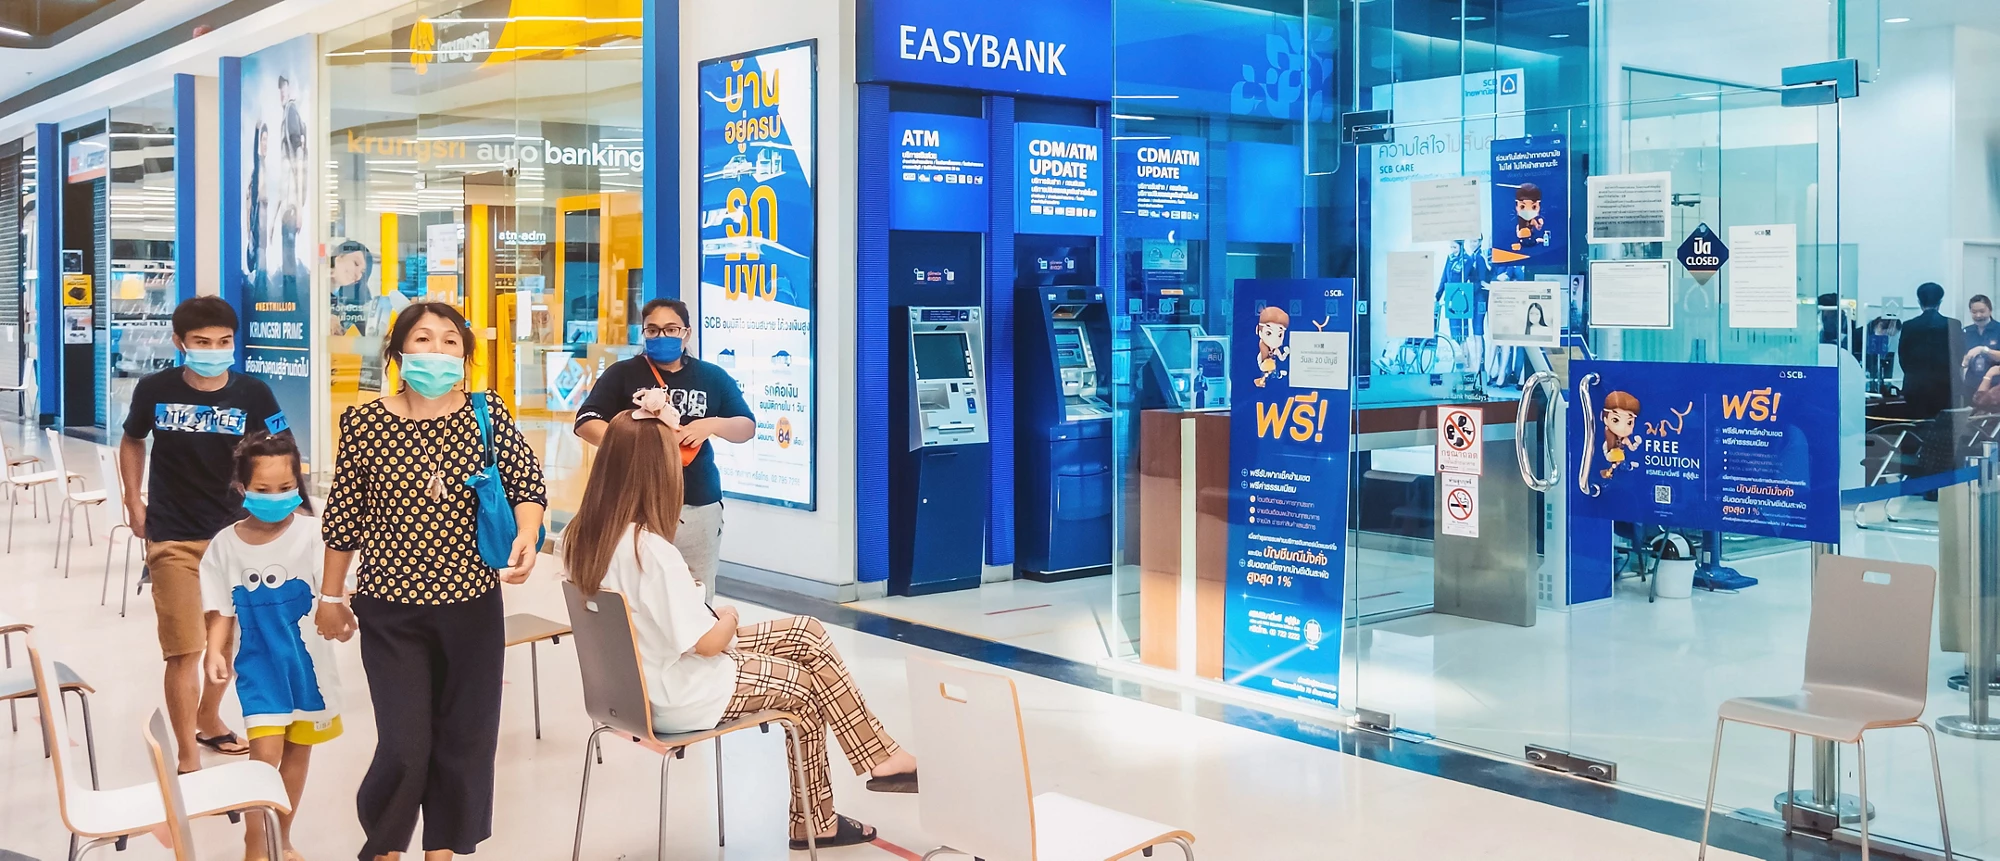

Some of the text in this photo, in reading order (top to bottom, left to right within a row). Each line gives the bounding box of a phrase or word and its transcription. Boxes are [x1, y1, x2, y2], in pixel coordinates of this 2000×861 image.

[900, 25, 1067, 76] EASYBANK
[724, 110, 781, 153] อยู่ครบ
[901, 129, 940, 147] ATM
[347, 129, 644, 172] krungsri auto banking
[1028, 139, 1098, 161] CDM/ATM
[1137, 147, 1200, 166] CDM/ATM
[1029, 158, 1088, 179] UPDATE
[1137, 165, 1180, 180] UPDATE
[1380, 164, 1414, 174] SCB CARE
[1693, 238, 1711, 255] ปิด
[1686, 256, 1719, 265] CLOSED
[249, 321, 303, 340] KRUNGSRI PRIME
[704, 316, 721, 329] SCB
[1786, 371, 1803, 379] SCB
[1722, 387, 1782, 422] ฟรี!
[161, 410, 244, 428] 7TH STREET
[1256, 391, 1328, 443] ฟรี!
[778, 428, 790, 444] 84
[1645, 440, 1679, 454] FREE
[1644, 455, 1700, 469] SOLUTION
